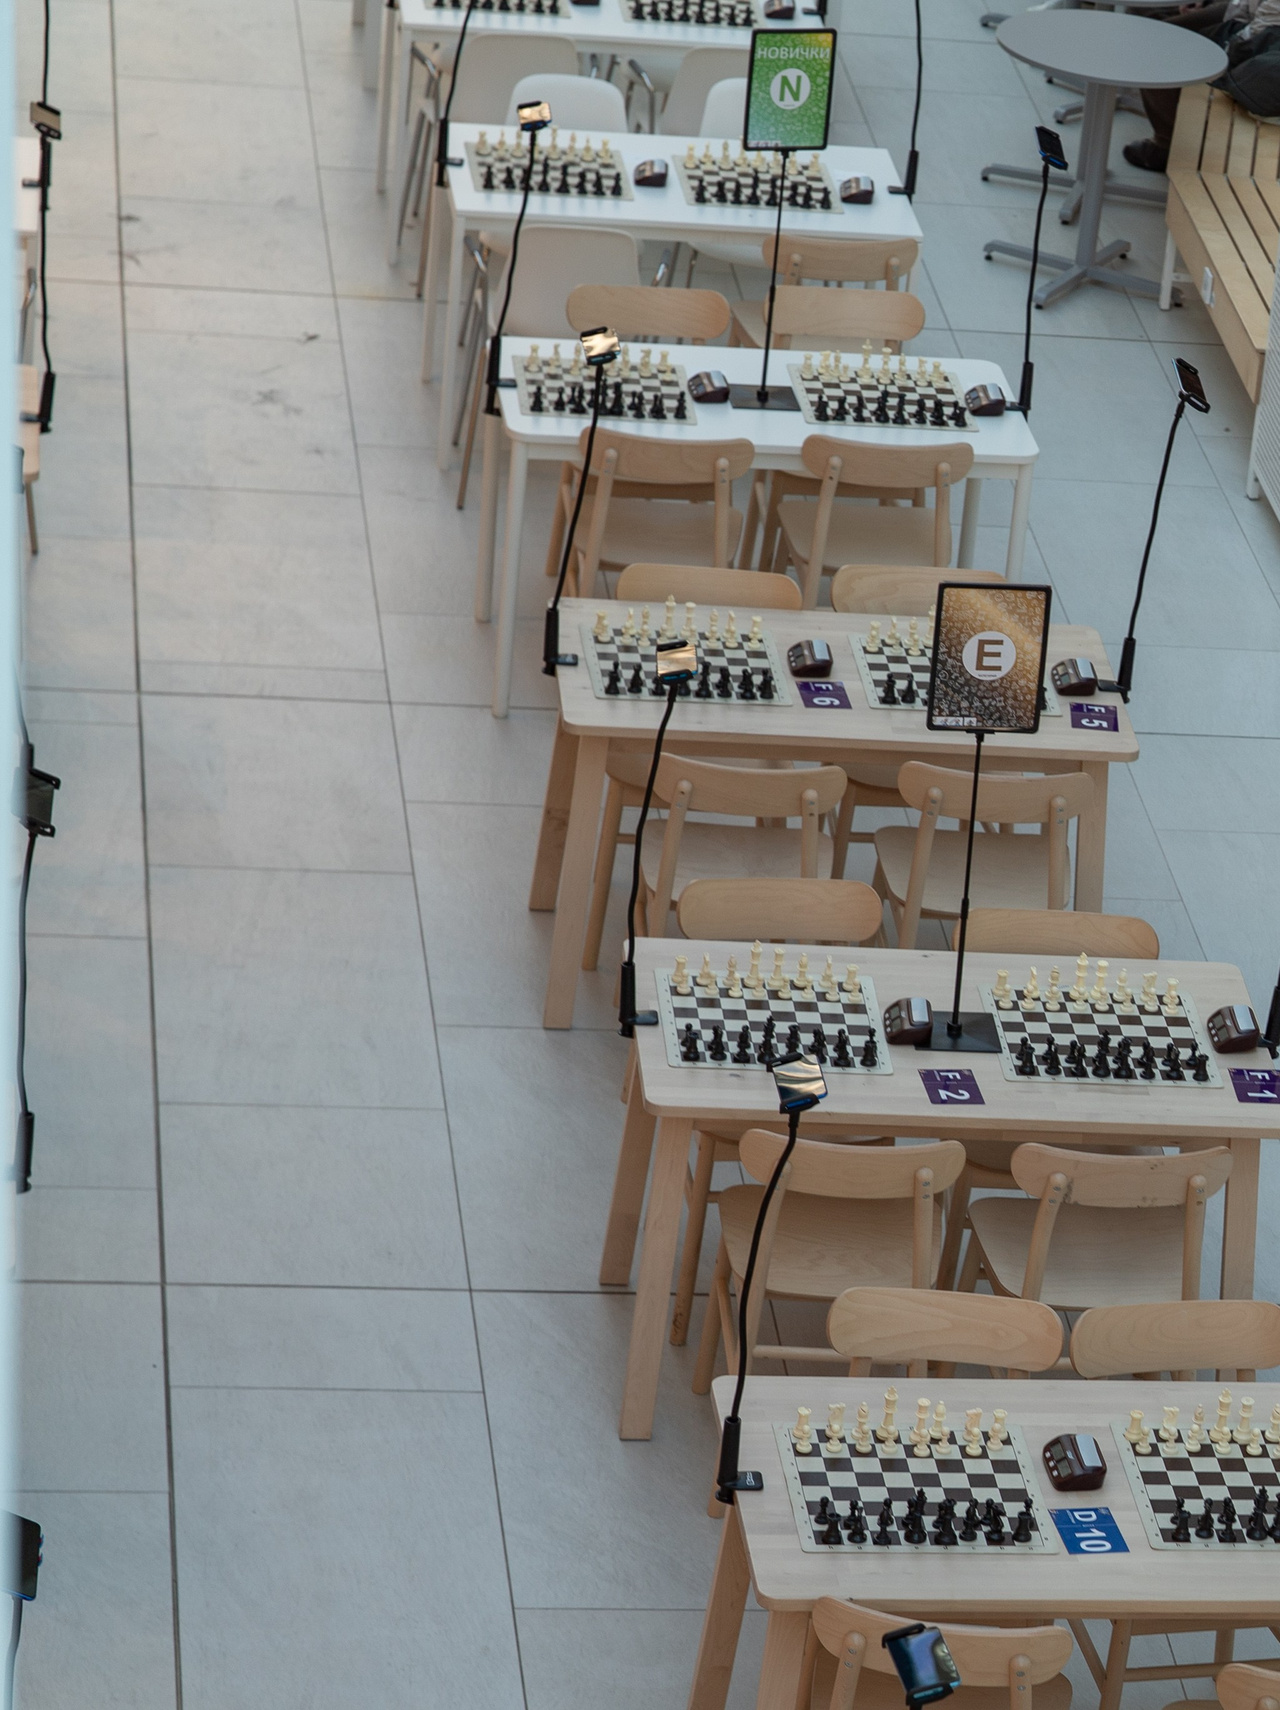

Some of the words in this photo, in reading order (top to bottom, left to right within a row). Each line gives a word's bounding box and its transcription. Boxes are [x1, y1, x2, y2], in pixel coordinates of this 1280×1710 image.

[757, 46, 831, 60] НОВИЧКИ
[778, 75, 803, 103] N
[975, 638, 1004, 672] E
[813, 683, 834, 691] F
[812, 696, 841, 707] 6
[1087, 705, 1107, 714] F
[1080, 718, 1109, 729] 5
[940, 1071, 962, 1081] F
[1248, 1071, 1271, 1081] F
[937, 1088, 971, 1101] 2
[1247, 1089, 1279, 1099] 1
[1072, 1510, 1098, 1522] D
[1074, 1527, 1113, 1552] 10
